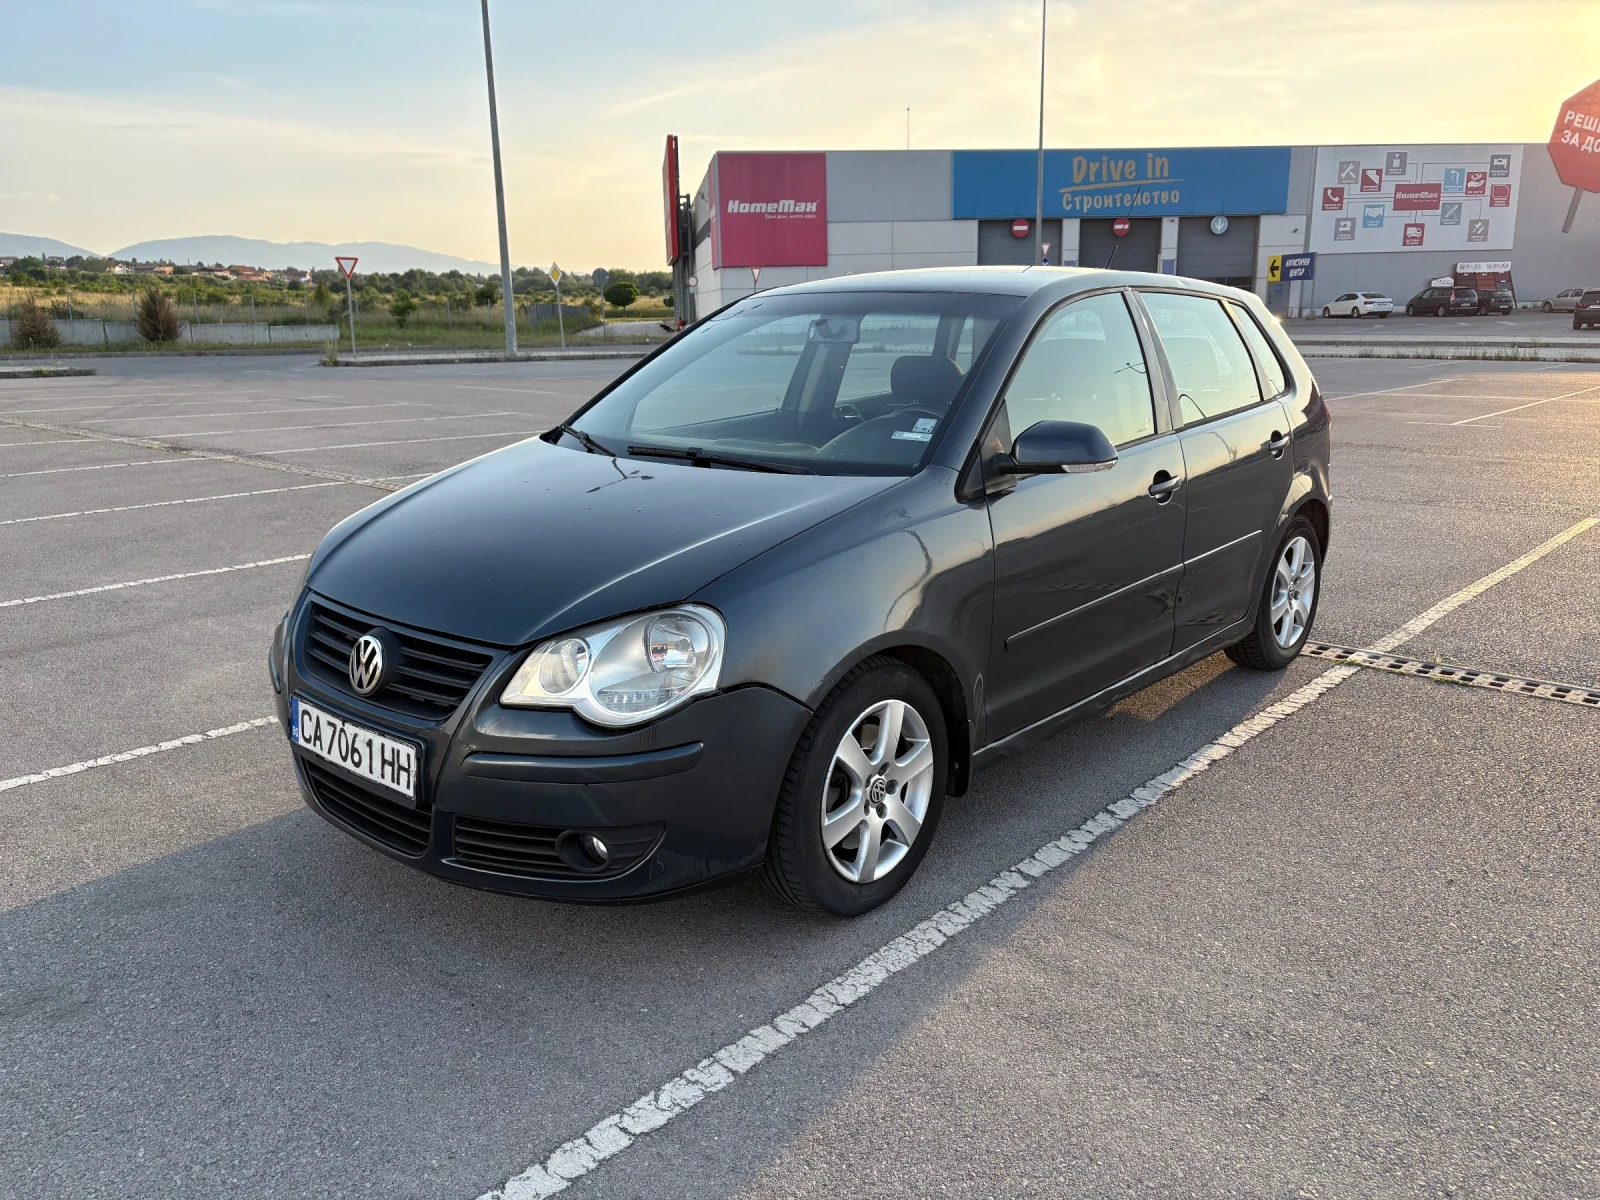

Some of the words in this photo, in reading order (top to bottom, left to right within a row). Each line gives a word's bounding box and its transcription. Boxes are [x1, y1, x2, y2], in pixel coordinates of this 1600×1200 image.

[1564, 109, 1600, 133] РЕШ
[1561, 129, 1579, 147] ЗА
[1072, 156, 1137, 183] Drive
[1146, 152, 1169, 178] in
[1062, 190, 1180, 213] Строителство
[1395, 191, 1438, 199] HomeMax
[727, 199, 817, 213] HomeMax
